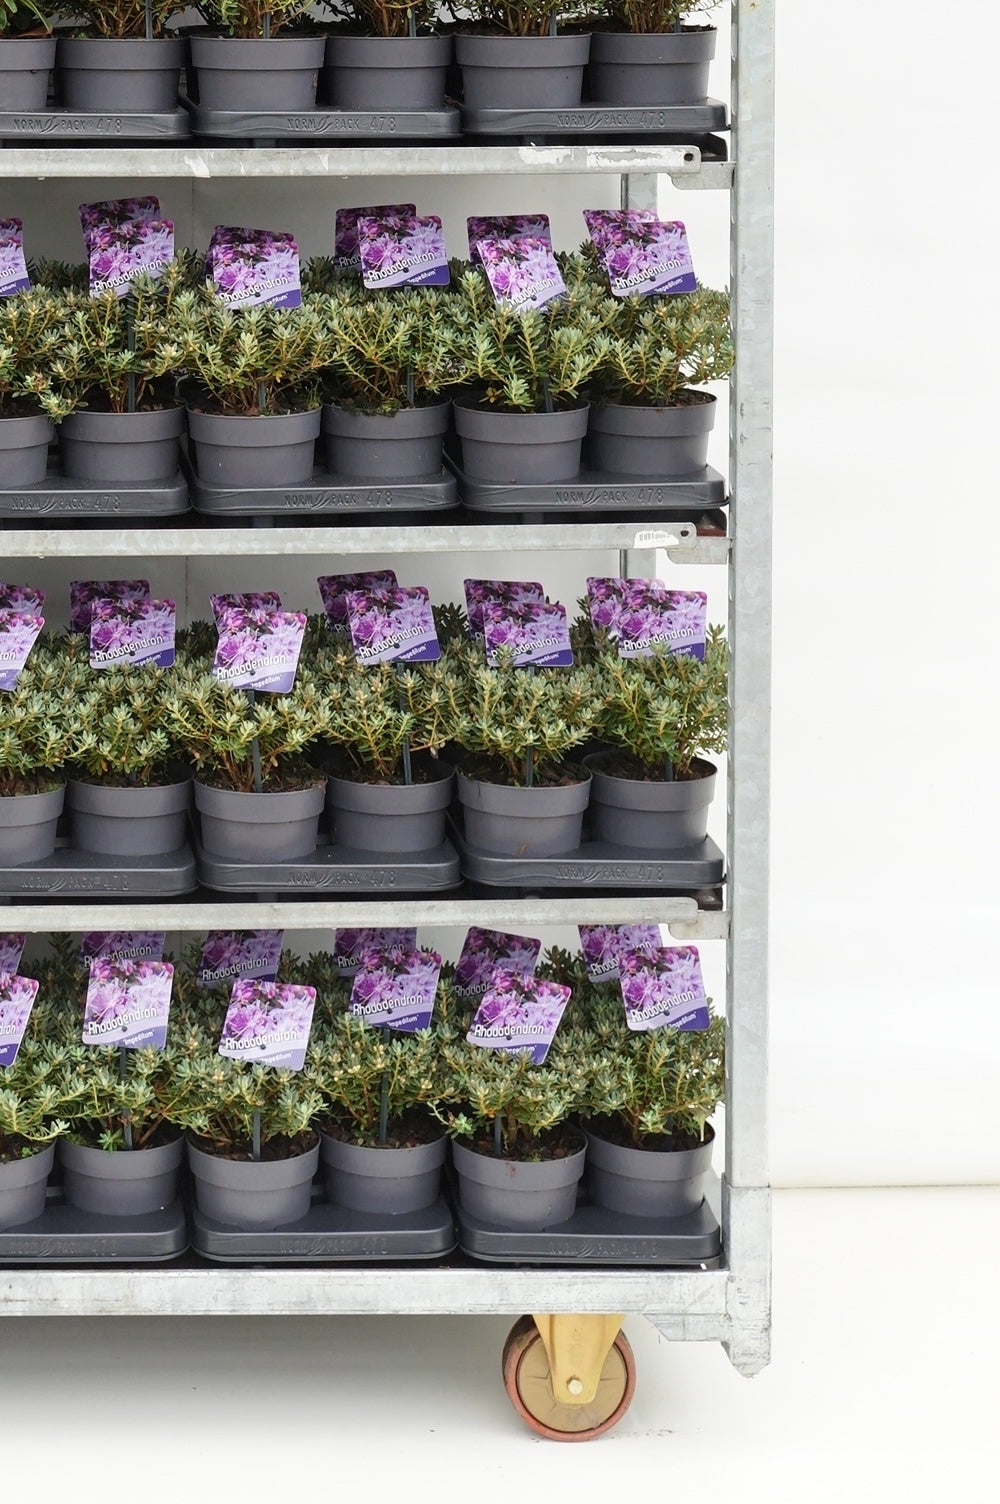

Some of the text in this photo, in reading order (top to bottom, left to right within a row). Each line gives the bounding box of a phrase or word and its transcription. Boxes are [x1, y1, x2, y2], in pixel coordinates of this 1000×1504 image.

[94, 260, 163, 292] Rhododendron
[368, 252, 435, 281] Rhododendron
[616, 258, 681, 289] Rhododendron
[94, 636, 164, 661] Rhododendron
[359, 625, 426, 659] Rhododendron
[216, 654, 287, 679] Rhododendron
[201, 956, 269, 980] Rhododendron
[352, 993, 424, 1015] Rhododendron
[630, 989, 695, 1021] Rhododendron
[87, 1005, 158, 1035] Rhododendron
[474, 1023, 545, 1037] Rhododendron
[224, 1028, 298, 1050] Rhododendron
